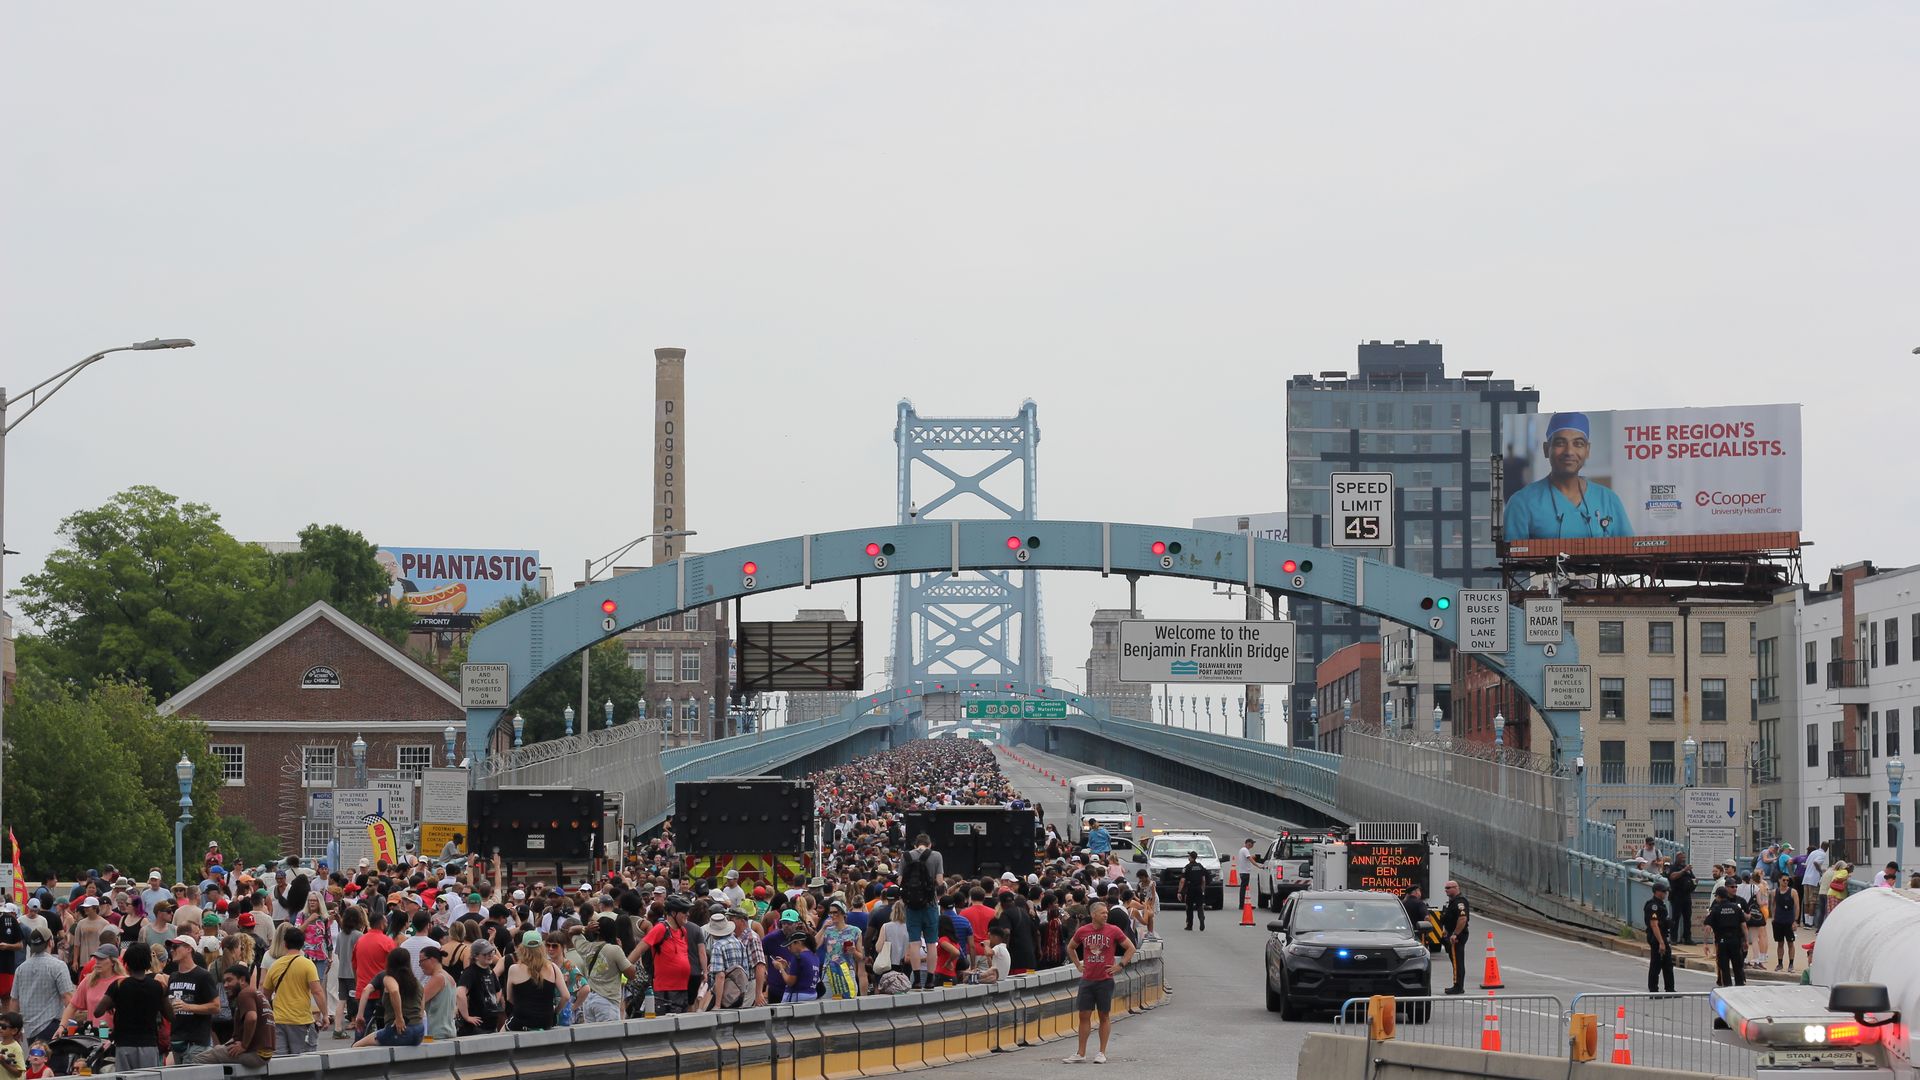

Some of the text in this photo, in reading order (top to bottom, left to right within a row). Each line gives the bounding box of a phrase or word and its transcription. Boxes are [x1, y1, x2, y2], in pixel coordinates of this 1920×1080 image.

[1624, 422, 1754, 442] THE REGION'S
[1624, 440, 1786, 460] TOP SPECIALISTS.
[1336, 482, 1387, 493] SPEED
[1651, 485, 1676, 494] BEST
[1712, 492, 1766, 507] Cooper
[1342, 500, 1382, 511] LIMIT
[1347, 518, 1378, 538] 45
[1019, 550, 1026, 560] 4
[877, 558, 884, 567] 3
[1163, 558, 1170, 566] 5
[402, 554, 536, 581] PHANTASTIC
[746, 578, 753, 586] 2
[1294, 576, 1302, 586] 6
[1433, 619, 1440, 628] 7
[1530, 616, 1558, 626] RADAR
[1155, 625, 1260, 640] Welcome to the
[1124, 642, 1289, 662] Benjamin Franklin Bridge
[1547, 645, 1554, 654] A
[1352, 856, 1421, 865] ANNIVERSARY
[1376, 867, 1397, 876] BEN
[1362, 878, 1411, 886] FRANKLIN
[1084, 934, 1110, 948] TEMPLE
